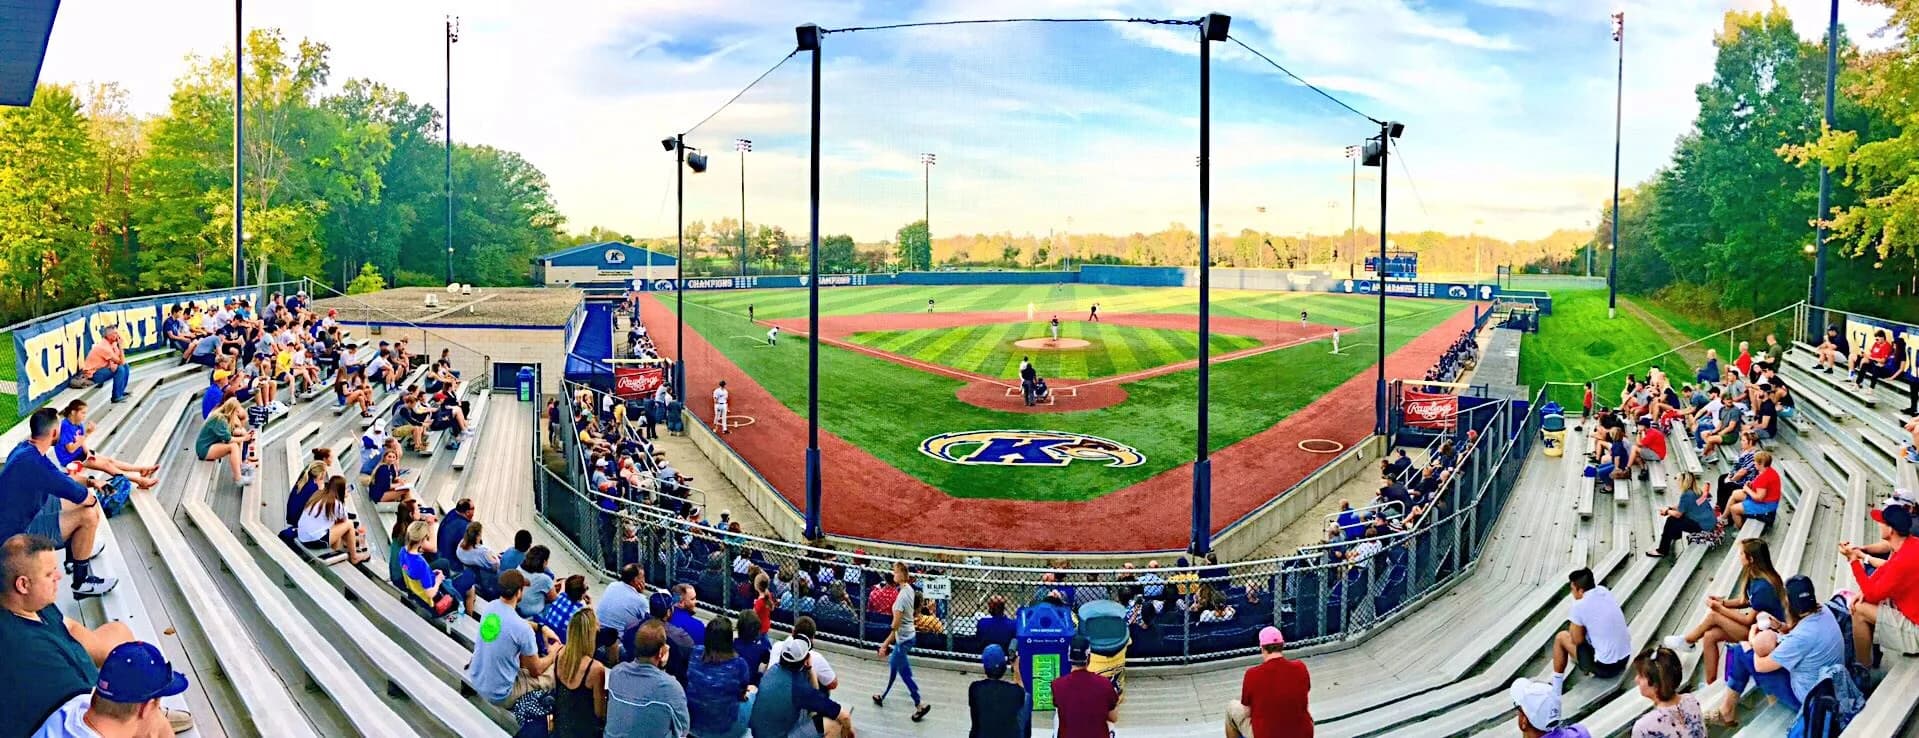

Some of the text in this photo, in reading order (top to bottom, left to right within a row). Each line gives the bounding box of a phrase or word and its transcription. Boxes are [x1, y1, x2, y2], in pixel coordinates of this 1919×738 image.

[687, 279, 733, 289] CHAMPIONS
[25, 316, 86, 402] KENT
[617, 375, 659, 391] Rawlings
[1407, 401, 1452, 420] Rawlings
[1036, 657, 1052, 706] RECYCLE
